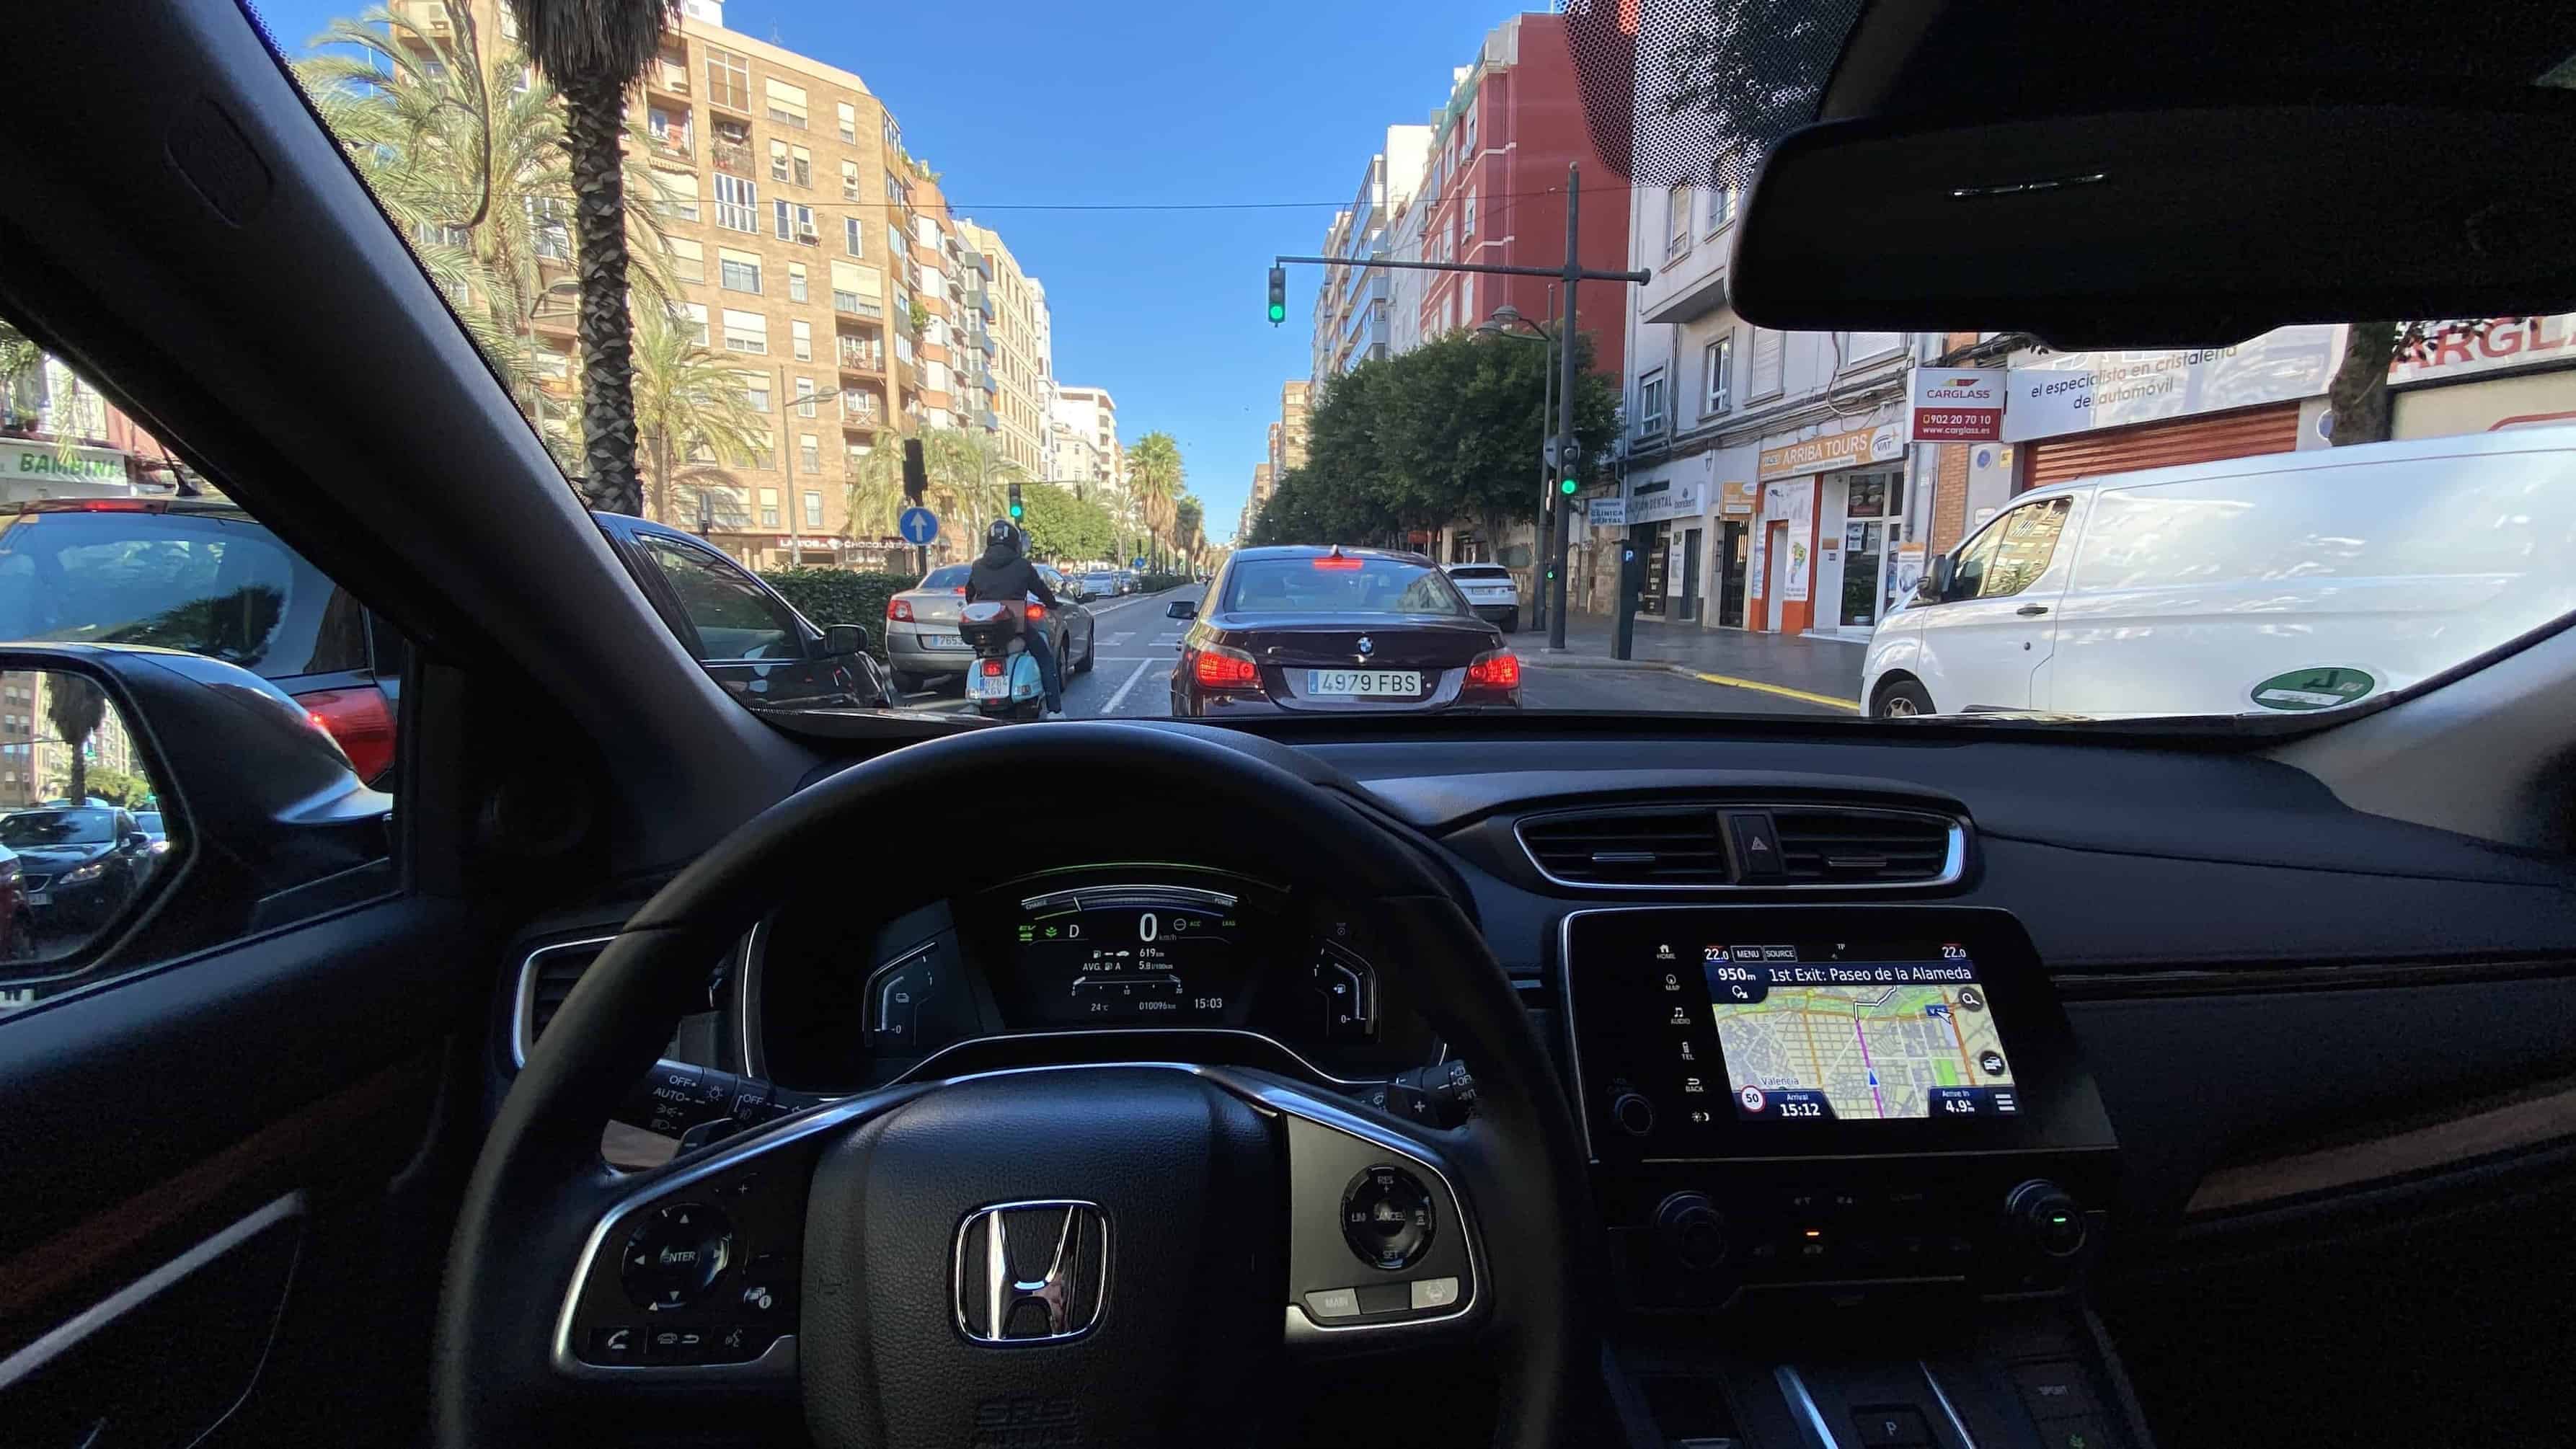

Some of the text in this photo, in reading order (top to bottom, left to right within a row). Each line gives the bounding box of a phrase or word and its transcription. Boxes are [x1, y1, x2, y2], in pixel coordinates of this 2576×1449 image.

[2031, 386, 2042, 398] el
[2046, 367, 2127, 394] especialista
[2131, 363, 2150, 378] en
[1926, 389, 1991, 399] CARGLASS
[2073, 377, 2174, 409] del automóvil
[1931, 415, 1991, 425] 902 20 70 10
[1782, 443, 1823, 465] ARRIBA
[1825, 433, 1867, 456] TOURS
[1625, 550, 1634, 561] P
[1323, 674, 1415, 692] 4979 FBS
[1068, 924, 1080, 939] D
[1139, 912, 1158, 943] 0
[1704, 948, 1729, 961] 22.0
[1737, 949, 1759, 959] MENU
[1766, 949, 1794, 959] SOURCE
[1942, 947, 1966, 959] 22.0
[1770, 966, 1972, 982] 1st Exit: Paseo de la Alameda
[1194, 997, 1223, 1009] 15:03
[668, 1075, 692, 1086] OFF
[1760, 1077, 1800, 1086] Valencia
[652, 1087, 686, 1102] AUTO
[742, 1093, 765, 1105] OFF
[1745, 1094, 1760, 1103] 50
[1779, 1103, 1821, 1117] 15:12
[1885, 1419, 1898, 1436] P
